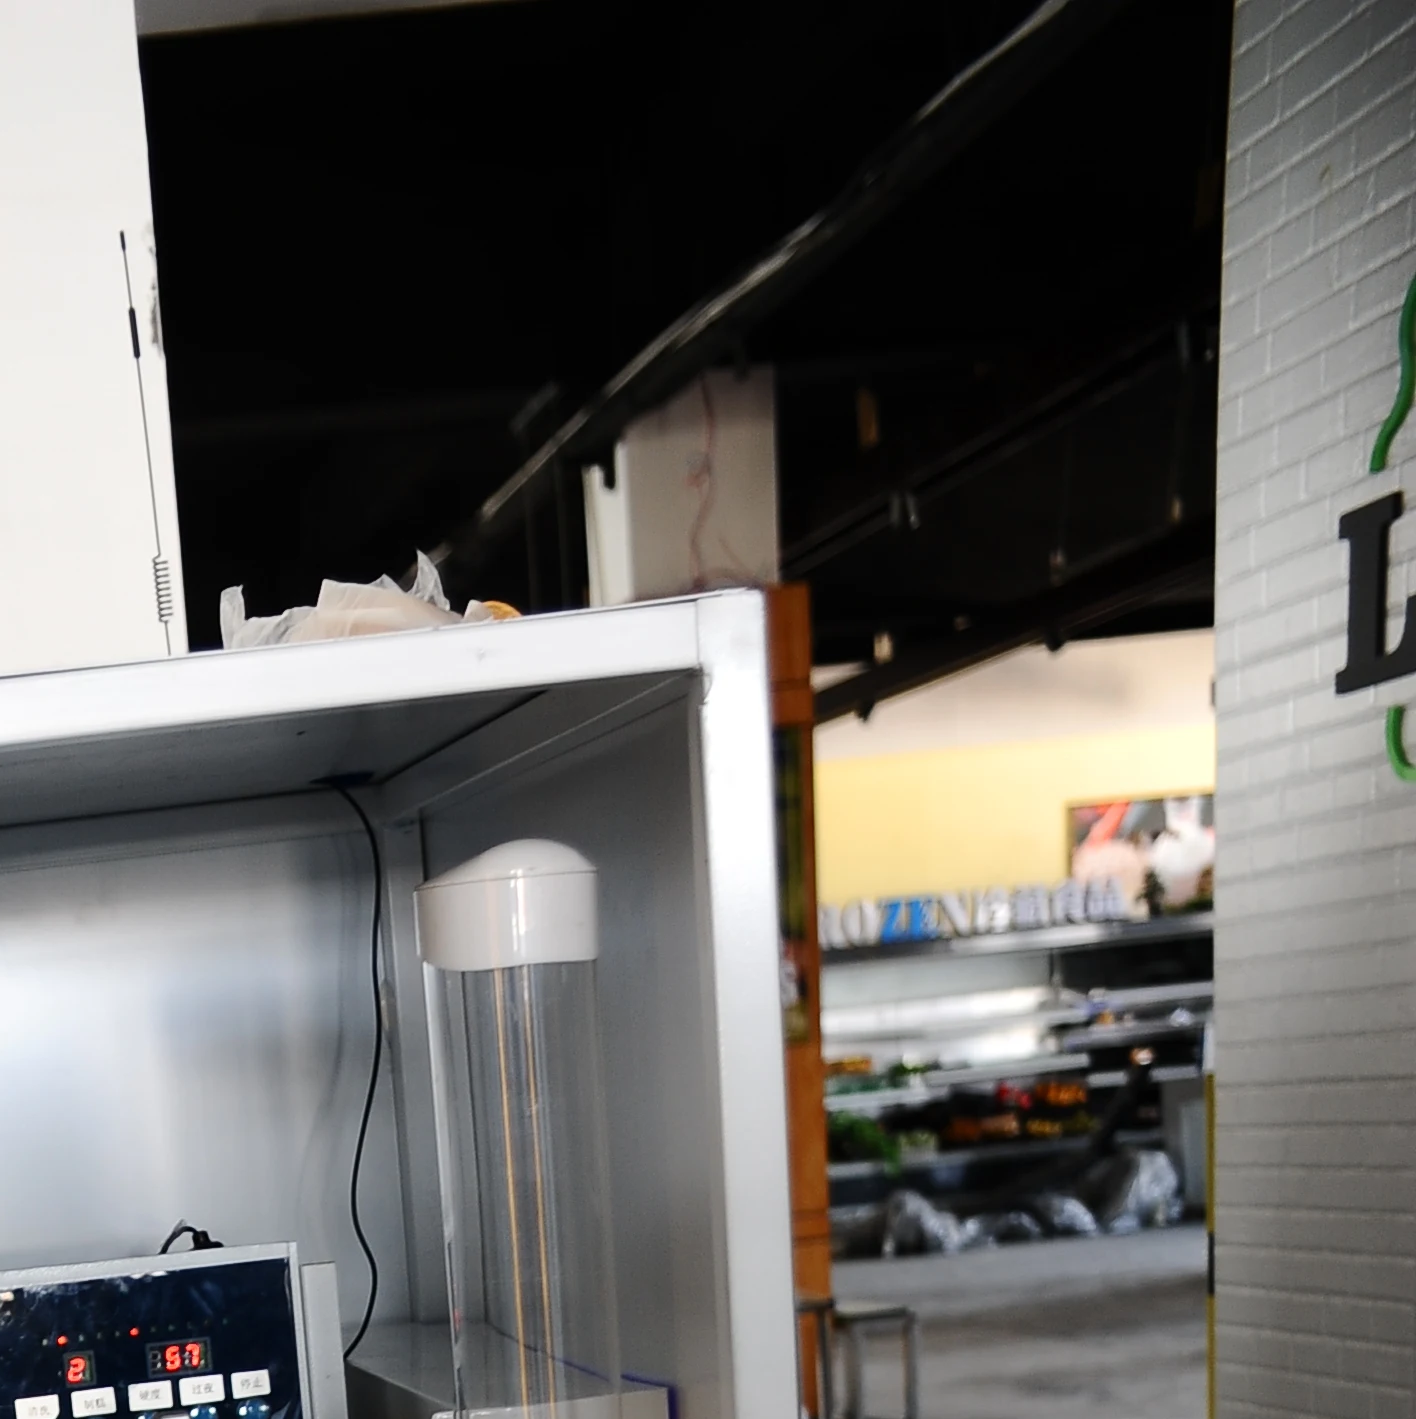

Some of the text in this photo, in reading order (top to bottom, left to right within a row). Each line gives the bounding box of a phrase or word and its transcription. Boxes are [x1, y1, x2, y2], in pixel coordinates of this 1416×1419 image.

[67, 1356, 86, 1384] 2
[165, 1341, 201, 1372] 57
[240, 1376, 264, 1389] 停止
